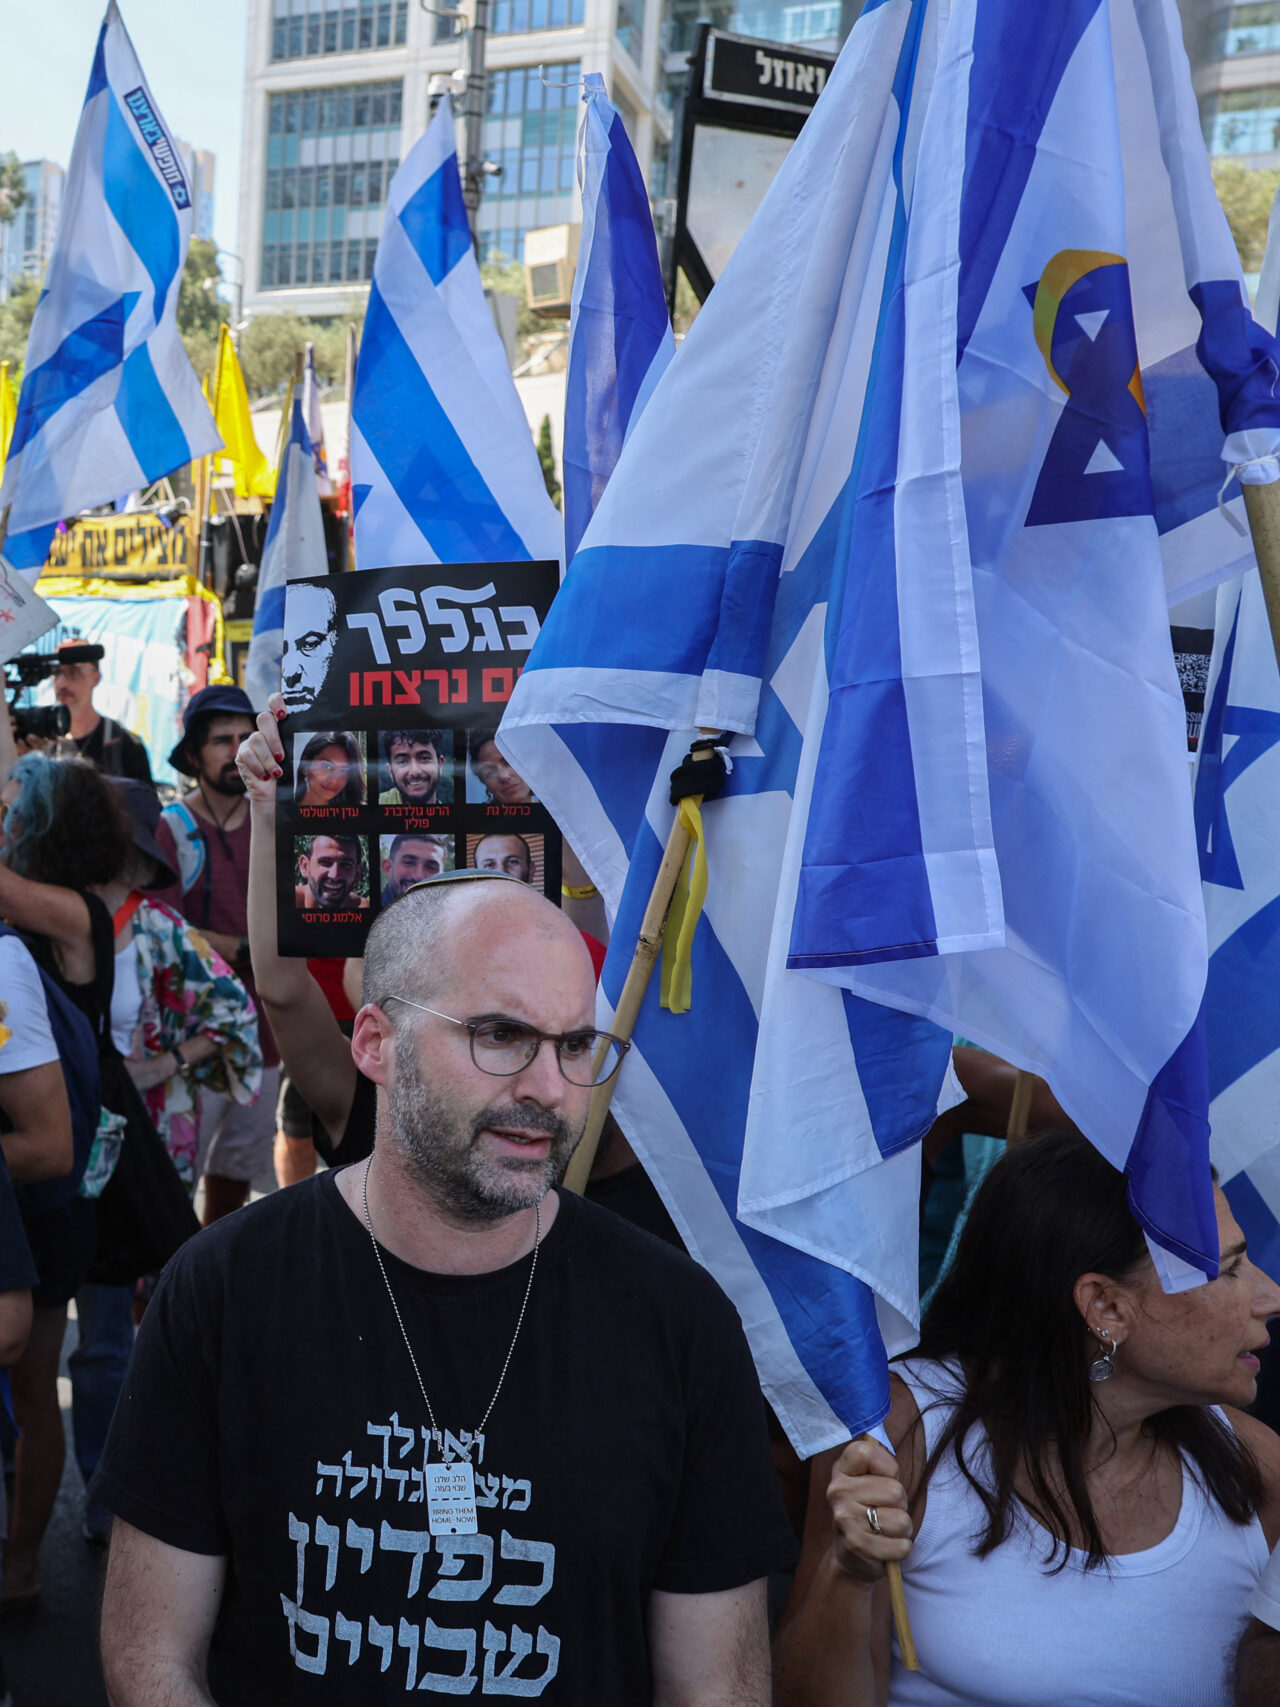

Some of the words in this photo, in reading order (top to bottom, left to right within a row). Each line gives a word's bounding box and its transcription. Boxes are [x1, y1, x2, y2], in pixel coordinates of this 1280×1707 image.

[125, 90, 164, 144] בארצנו
[151, 136, 183, 185] חופשי
[349, 668, 468, 706] נרצחו
[299, 807, 340, 819] ירושלמי
[341, 807, 360, 820] עדן
[384, 806, 426, 817] גולדברג
[428, 806, 450, 817] הרש
[503, 805, 531, 817] כרמל
[404, 818, 430, 831] פולין
[302, 912, 331, 923] סרוסי
[332, 911, 362, 923] אלמוג
[366, 1411, 415, 1471] לך
[421, 1425, 486, 1468] ואין
[315, 1450, 424, 1503] גדולה
[434, 1475, 450, 1484] שלנו
[452, 1475, 466, 1483] הלב
[288, 1511, 556, 1608] כפדיון
[280, 1592, 561, 1697] שבויים
